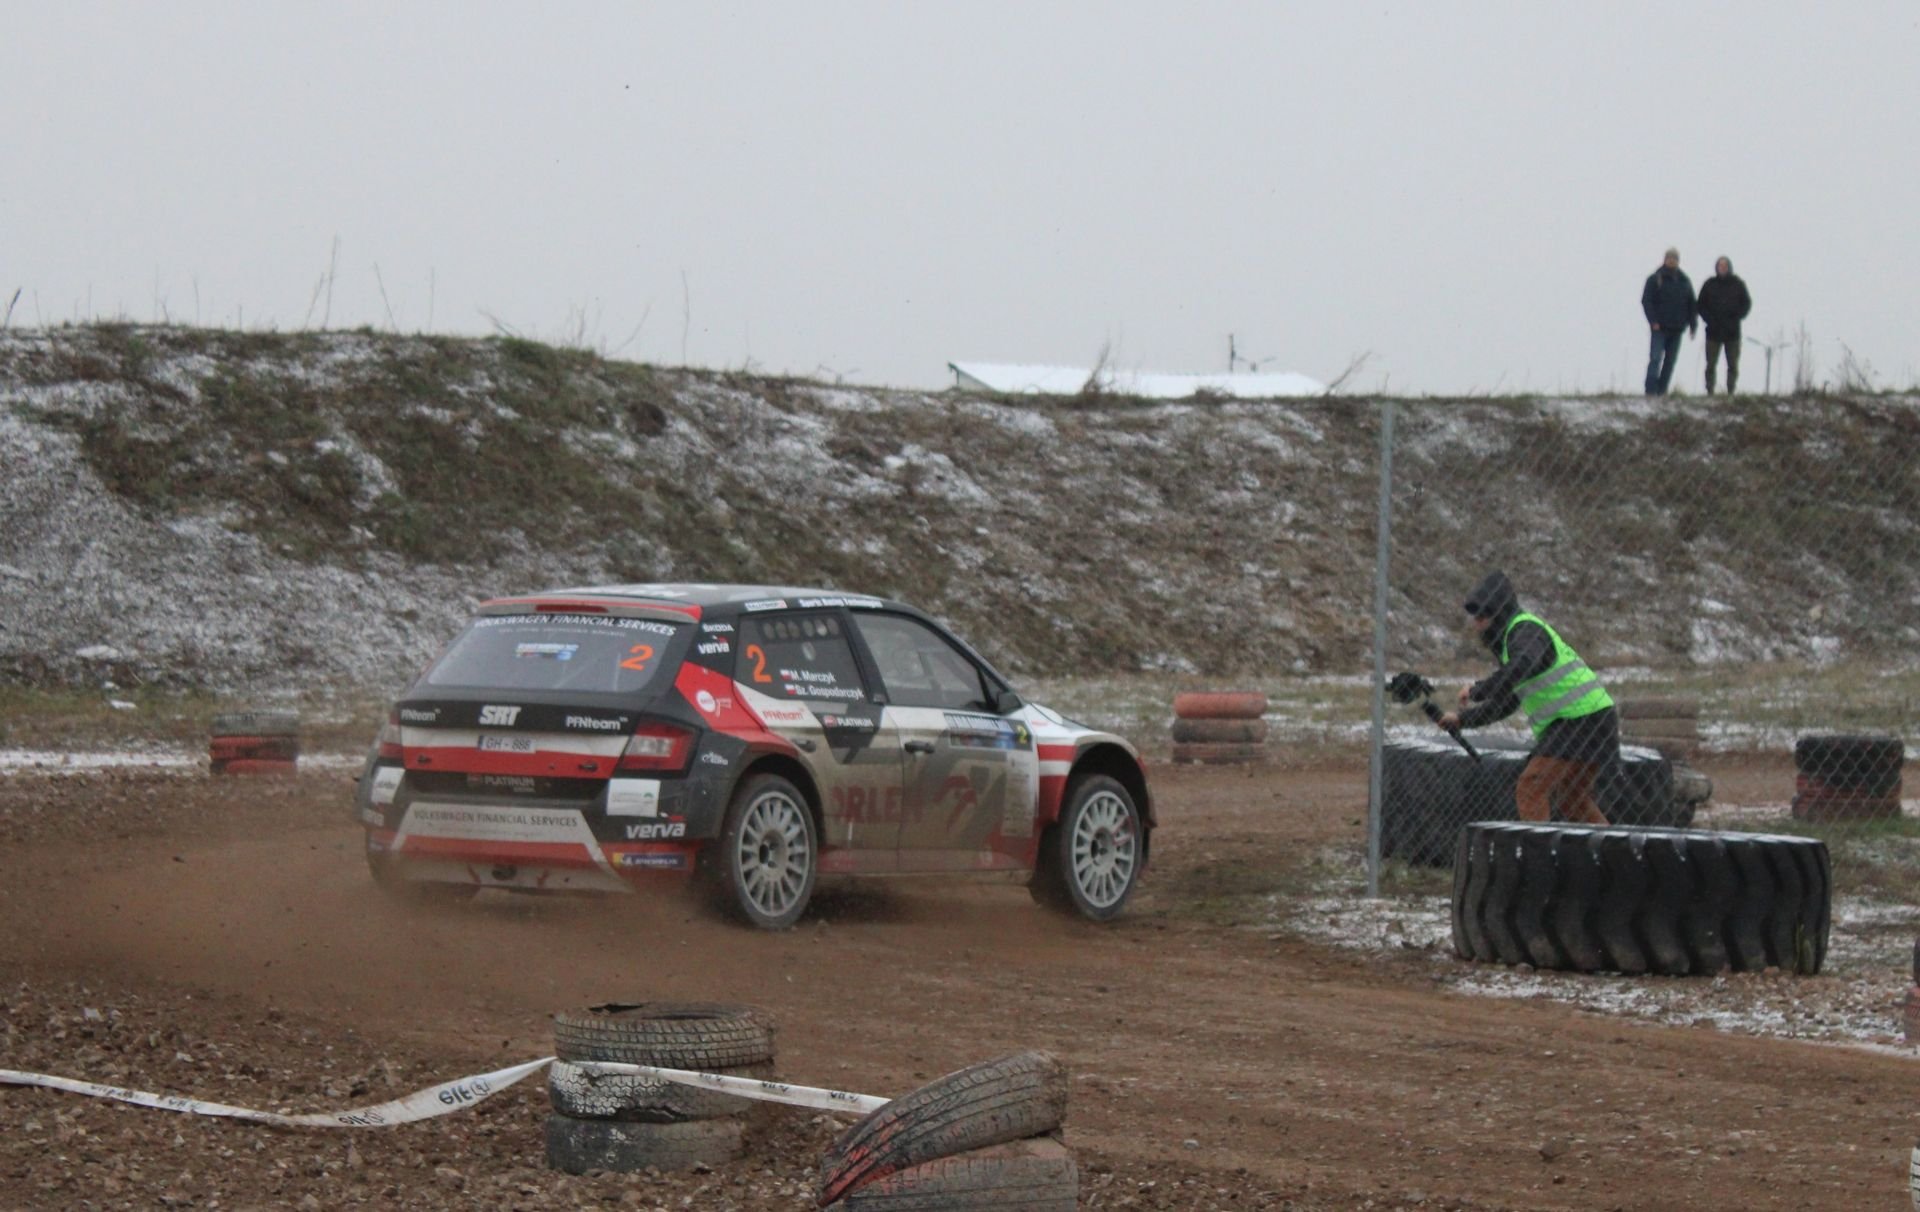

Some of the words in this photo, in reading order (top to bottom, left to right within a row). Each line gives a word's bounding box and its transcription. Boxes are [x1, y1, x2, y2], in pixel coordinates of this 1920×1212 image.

[551, 615, 615, 628] FINANCIAL
[617, 618, 676, 636] SERVICES
[698, 642, 730, 654] verva
[619, 644, 654, 670] 2
[746, 643, 772, 683] 2
[790, 668, 802, 681] M.
[802, 669, 836, 684] Marczyk
[479, 705, 521, 726] SRT
[565, 716, 622, 731] PFNteam
[485, 775, 534, 786] PLATINUM
[413, 809, 475, 823] VOLKSWAGEN
[477, 811, 527, 825] FINANCIAL
[530, 815, 578, 827] SERVICES
[626, 824, 686, 839] verva
